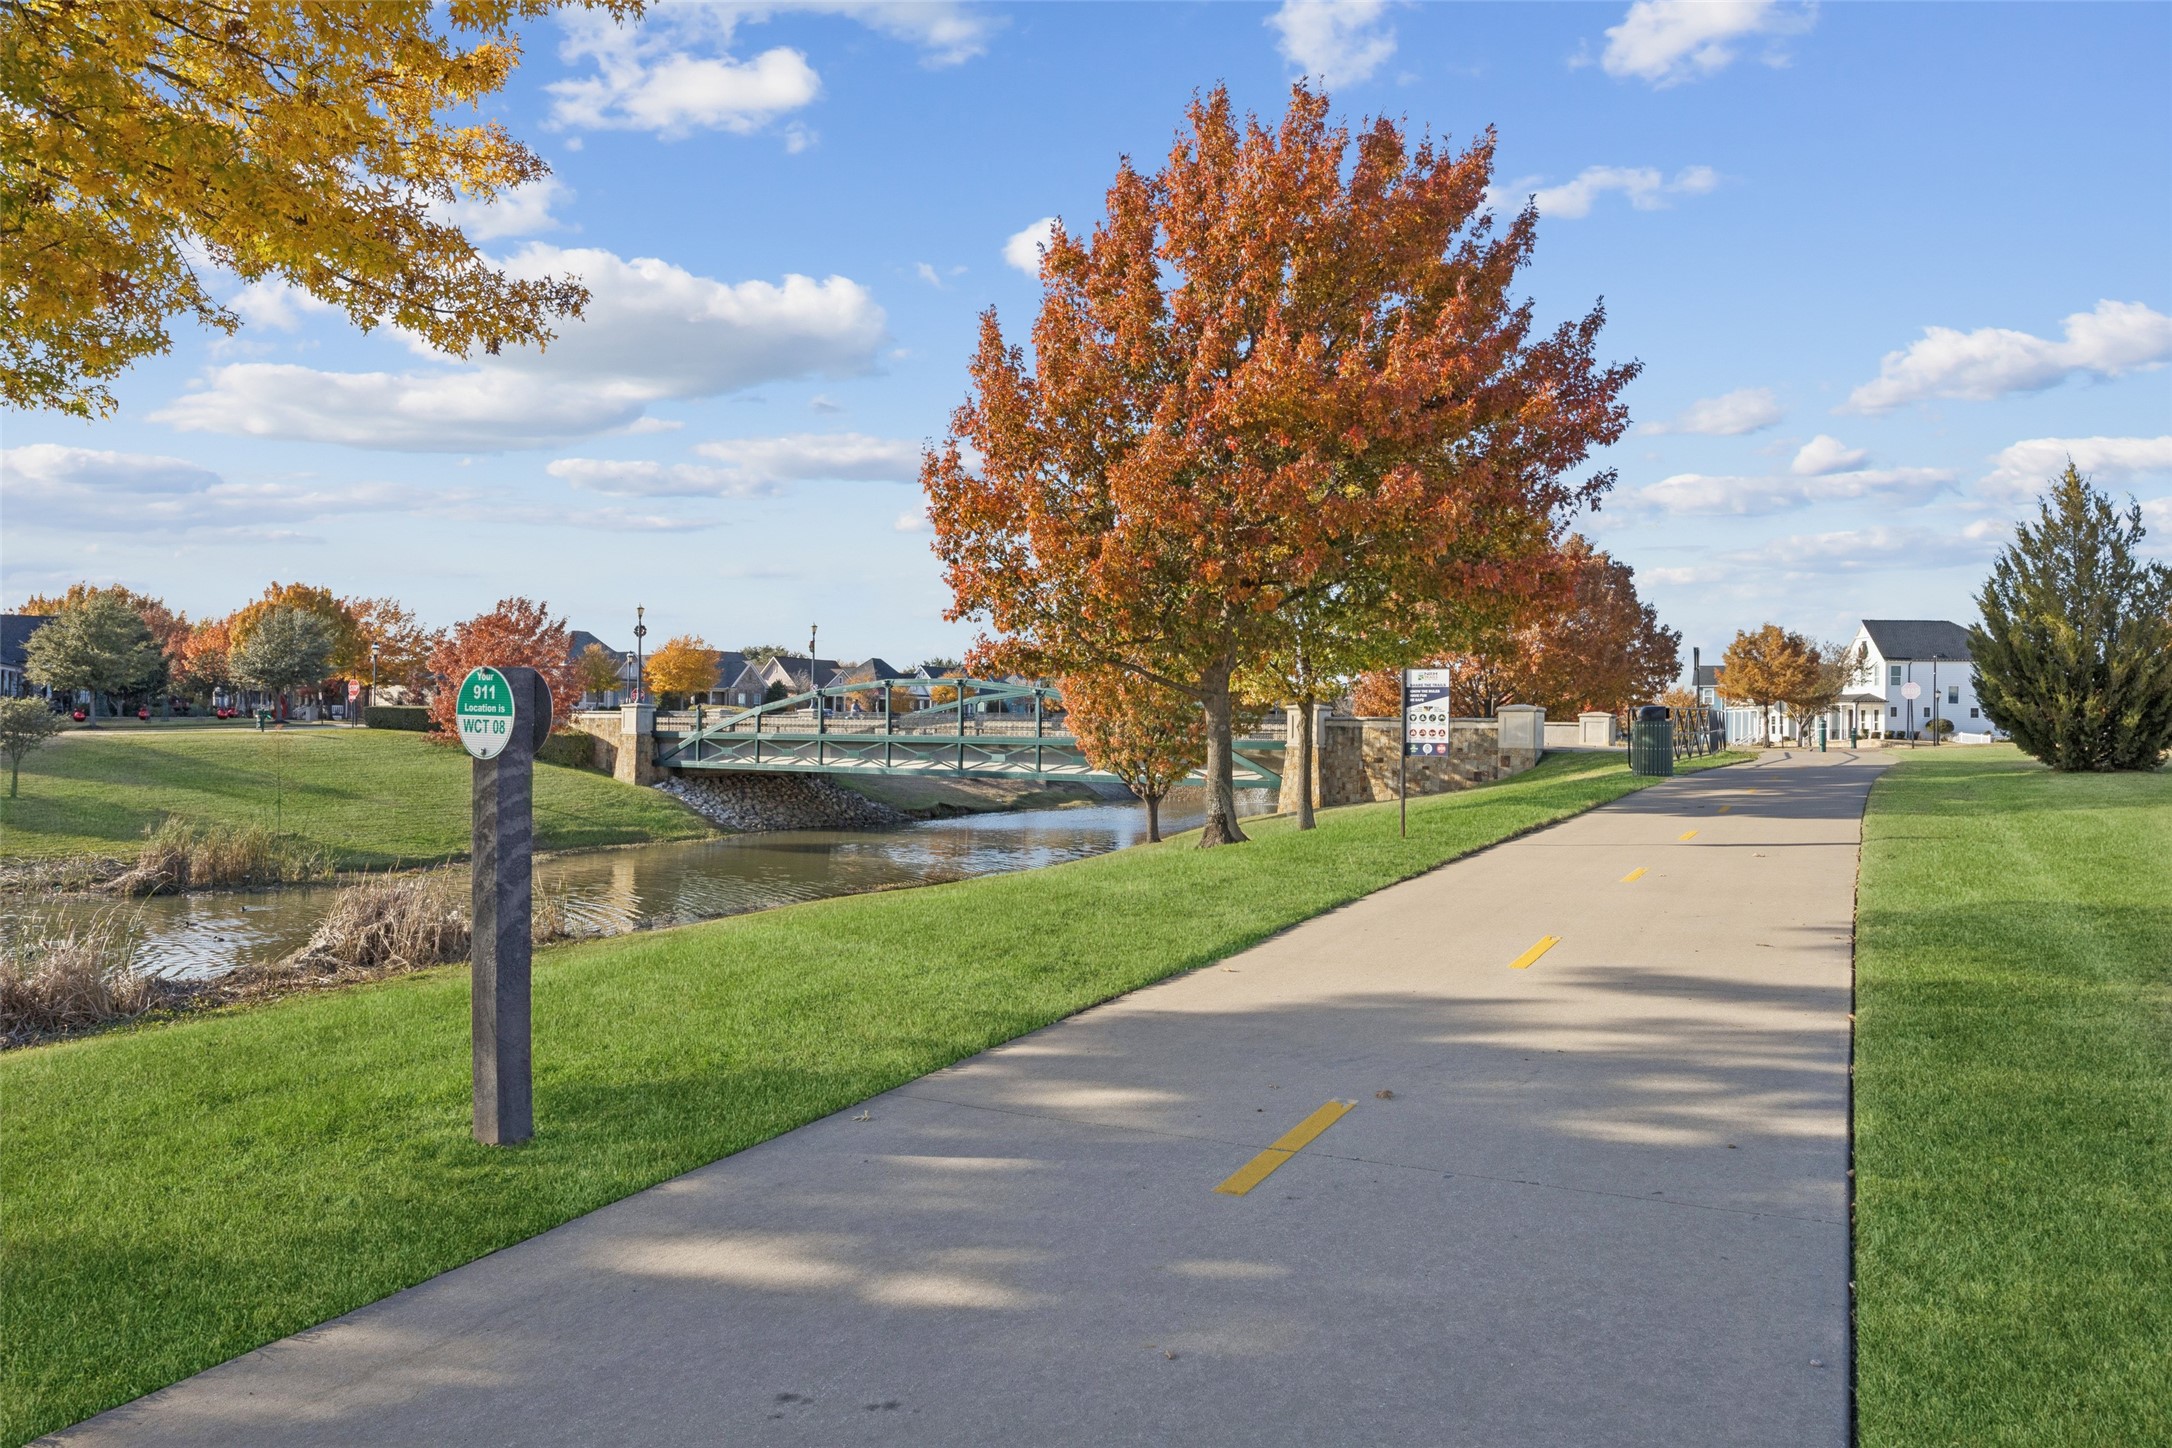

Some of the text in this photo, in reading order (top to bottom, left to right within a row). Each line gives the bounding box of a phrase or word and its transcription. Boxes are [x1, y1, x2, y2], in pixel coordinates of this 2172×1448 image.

[477, 672, 494, 680] Your
[473, 685, 495, 699] 911
[465, 703, 505, 712] Location is
[464, 719, 505, 734] WCT 08
